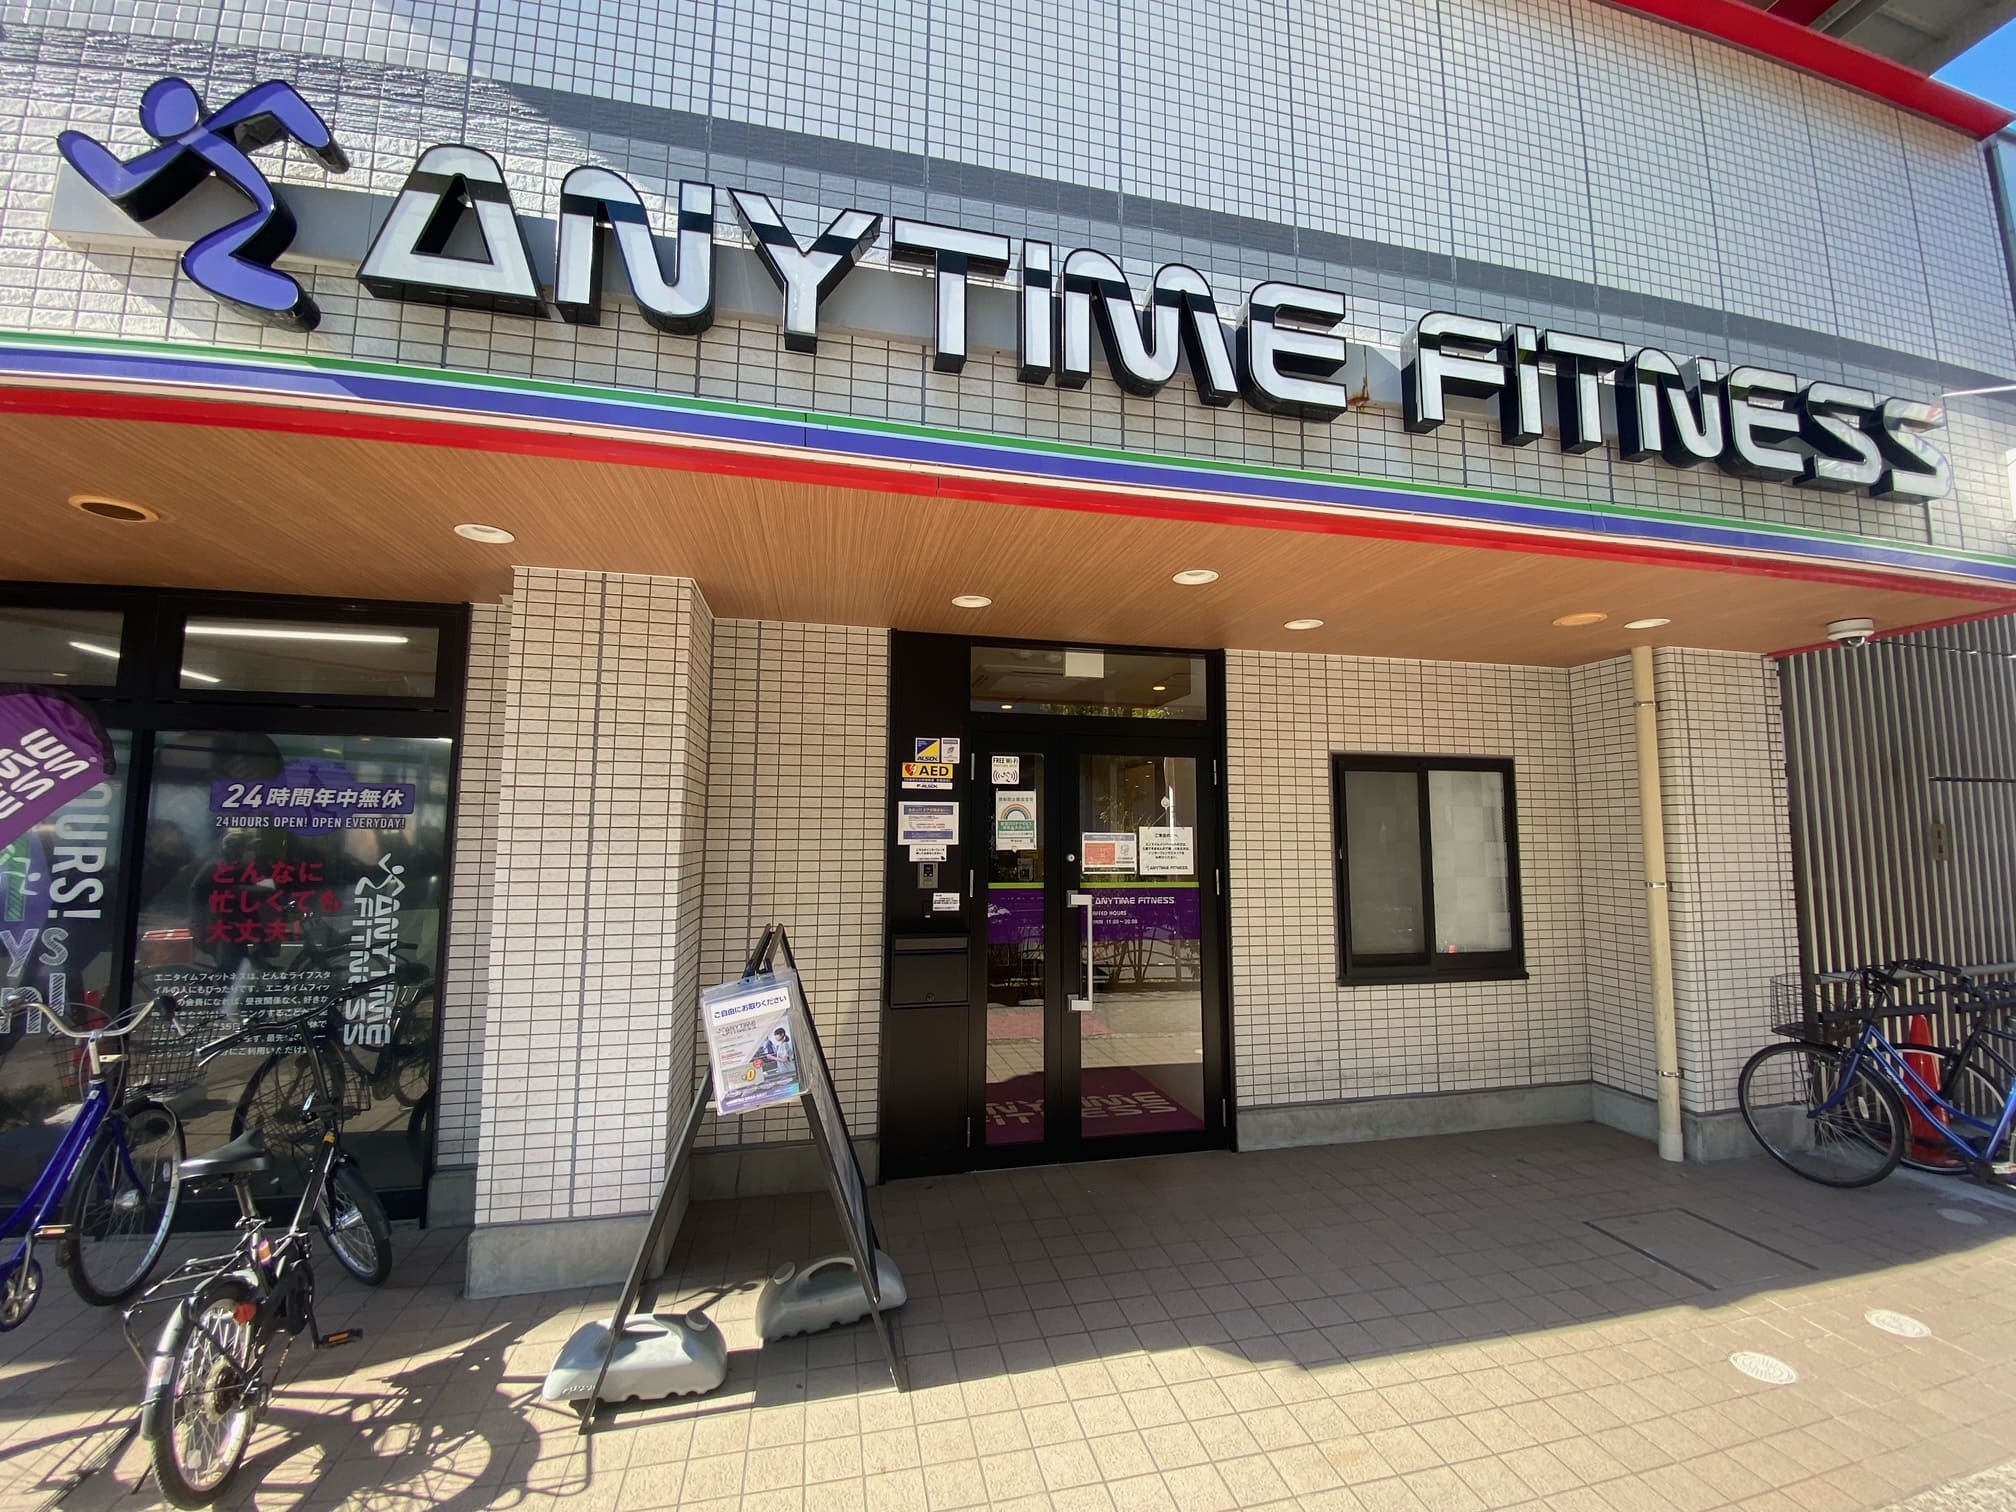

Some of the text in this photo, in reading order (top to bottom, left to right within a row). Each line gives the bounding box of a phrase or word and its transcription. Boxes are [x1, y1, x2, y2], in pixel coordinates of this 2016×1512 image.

[356, 143, 1954, 503] ANYTIME FITNESS
[919, 766, 949, 776] AED
[222, 783, 405, 809] 24時間年中無休
[273, 816, 308, 828] OPEN!
[312, 816, 342, 828] OPEN
[345, 816, 406, 829] EVERYDAY!
[212, 860, 325, 884] どんなに
[208, 889, 342, 913] 忙しくても
[1095, 896, 1175, 905] ANYTIME FITNESS
[714, 995, 787, 1019] ご自由にお取りください
